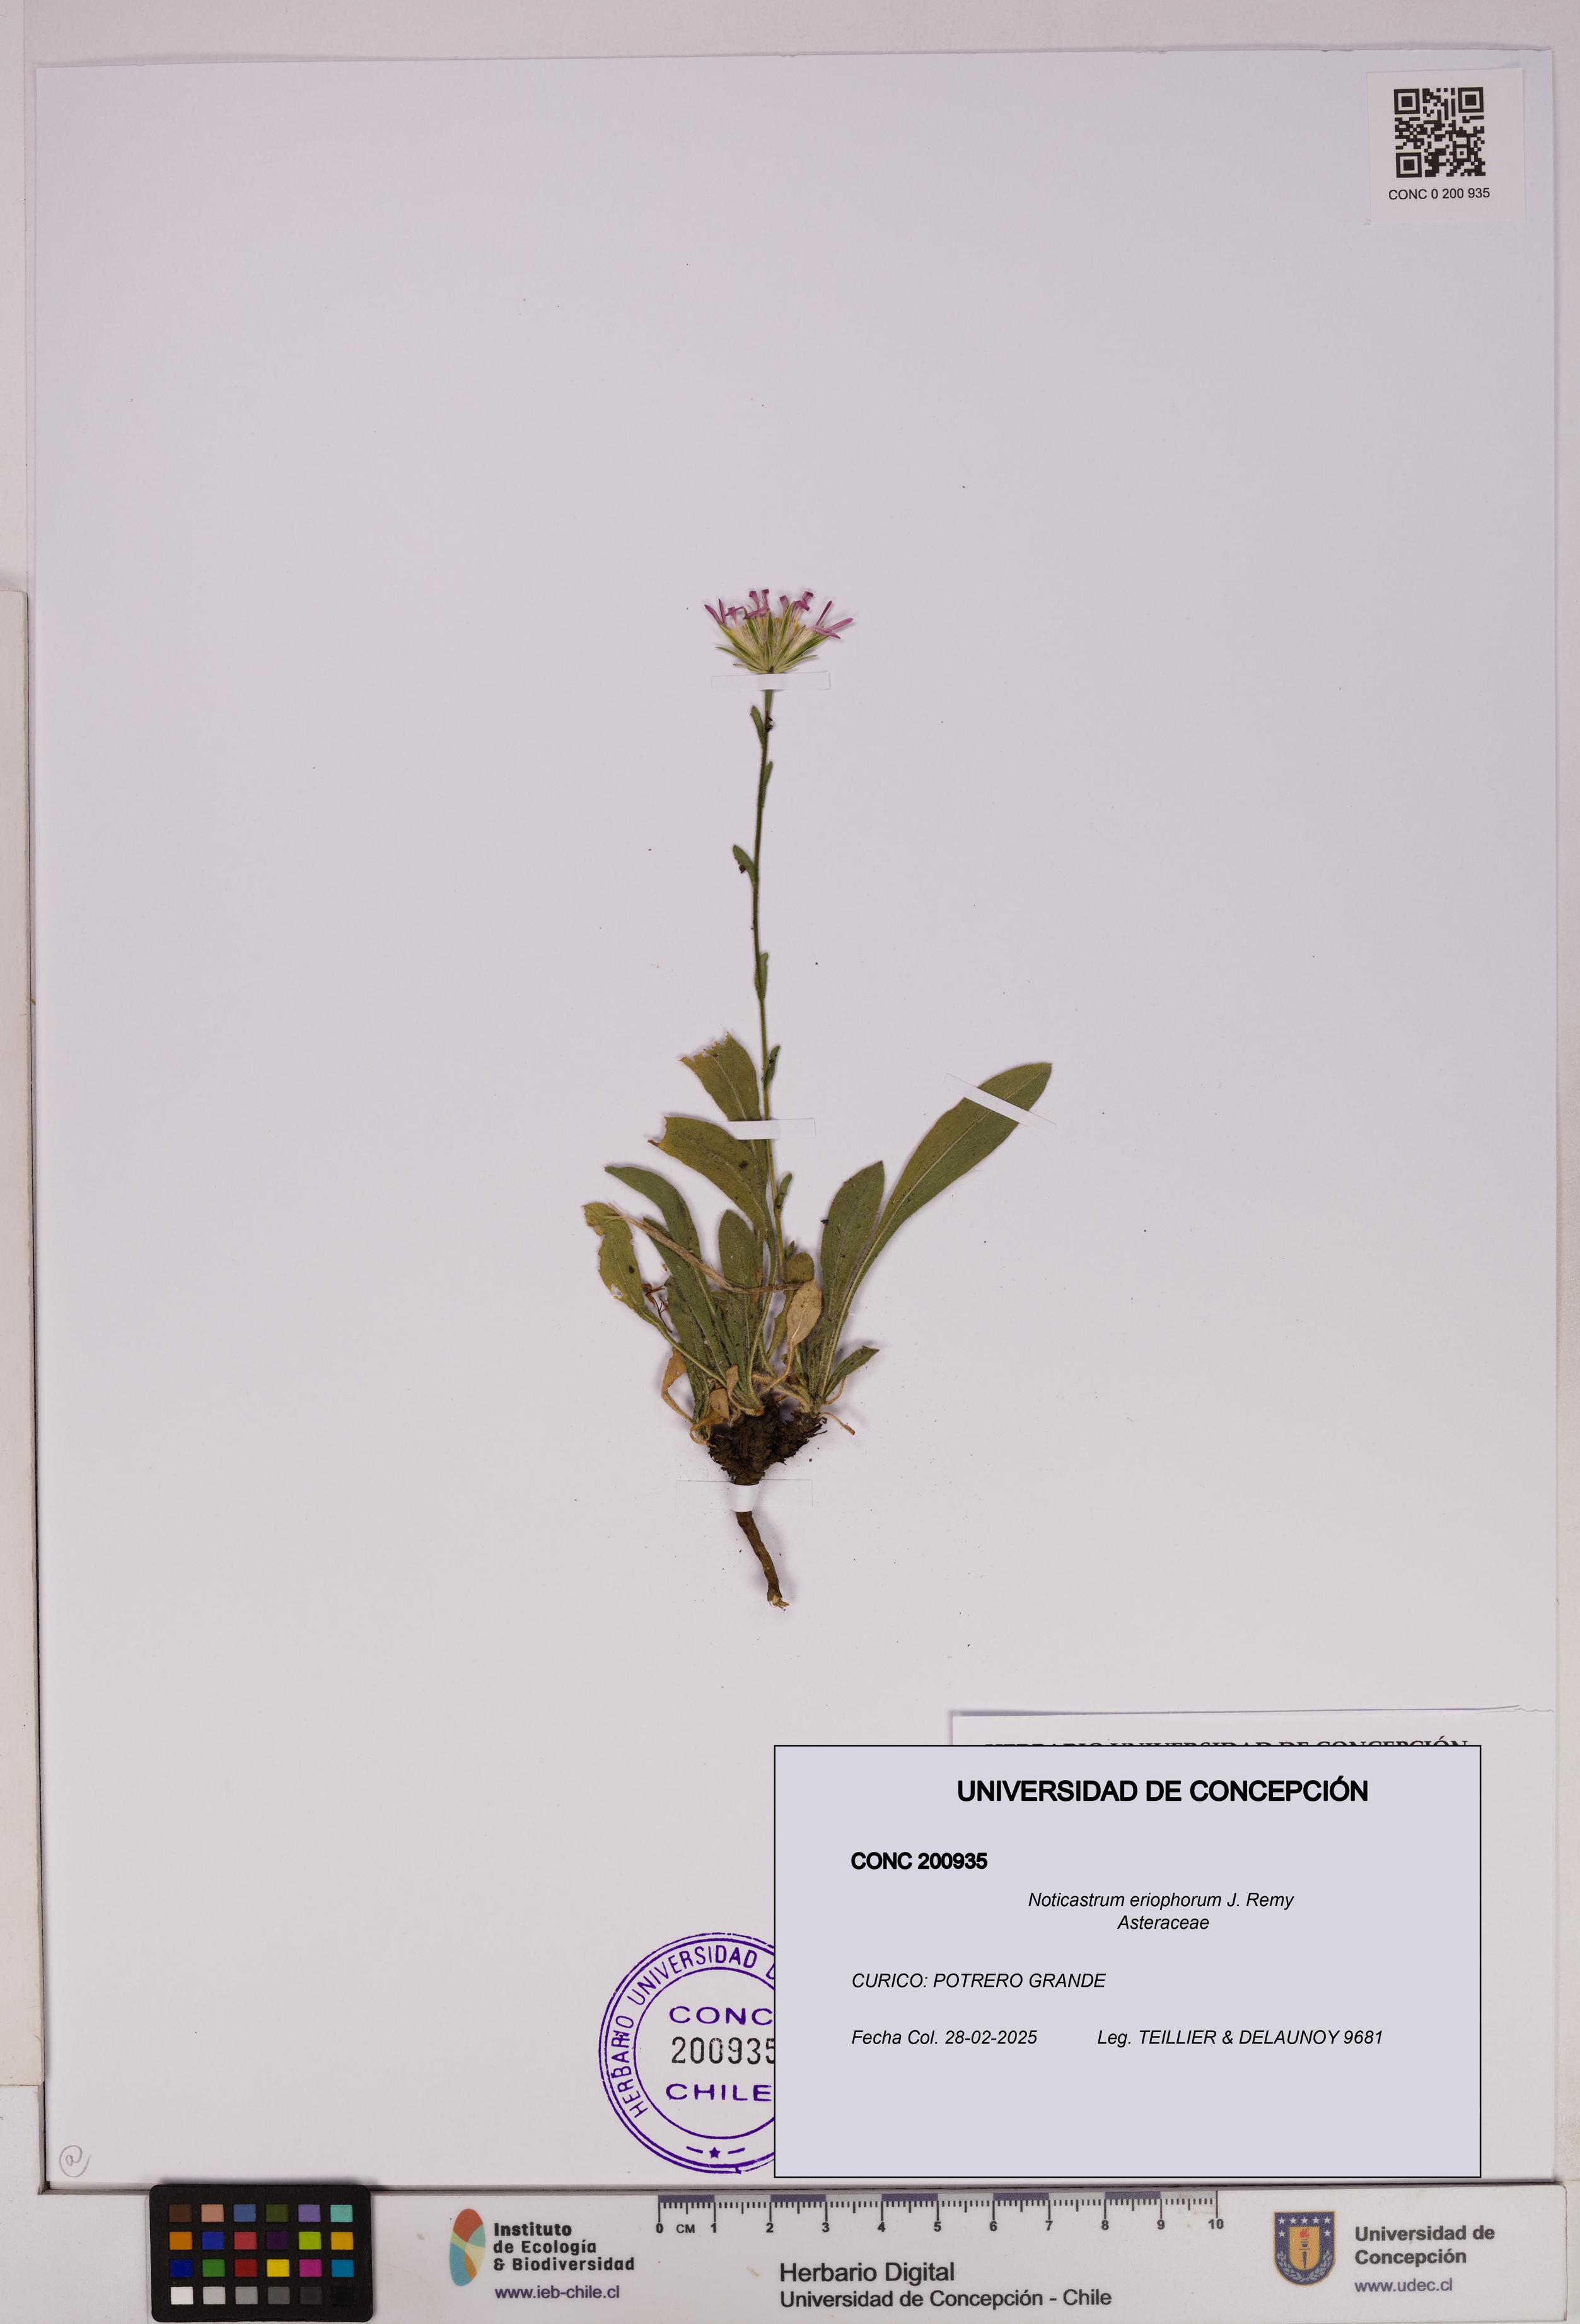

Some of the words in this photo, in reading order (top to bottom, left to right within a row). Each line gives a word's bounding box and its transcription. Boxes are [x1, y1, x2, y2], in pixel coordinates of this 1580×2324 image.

[1388, 188, 1427, 200] CONC
[1431, 189, 1438, 199] 0
[1442, 188, 1464, 199] 200
[1468, 188, 1490, 199] 935
[627, 1945, 757, 2006] UNIVERSIDAD
[669, 2006, 773, 2026] CONC
[671, 2037, 774, 2065] 200935
[666, 2083, 772, 2101] CHILE
[494, 2222, 572, 2236] Instituto
[656, 2223, 664, 2234] 0
[676, 2224, 695, 2233] CM
[710, 2223, 717, 2233] 1
[766, 2223, 774, 2233] 2
[822, 2223, 830, 2233] 3
[877, 2222, 886, 2233] 4
[933, 2222, 942, 2233] 5
[989, 2221, 997, 2232] 6
[1045, 2221, 1054, 2231] 7
[1101, 2219, 1110, 2231] 8
[1157, 2219, 1166, 2230] 9
[1208, 2219, 1224, 2229] 10
[1355, 2225, 1467, 2242] Universidad
[1472, 2224, 1496, 2240] de
[493, 2240, 514, 2253] de
[521, 2240, 596, 2256] Ecología
[494, 2258, 505, 2271] &
[512, 2257, 635, 2271] Biodiversidad
[1354, 2248, 1467, 2268] Concepción
[780, 2262, 877, 2282] Herbario
[885, 2262, 955, 2287] Digital
[494, 2285, 620, 2299] www.ieb-chile.cl
[1354, 2277, 1453, 2292] www.udec.cl
[781, 2291, 893, 2308] Universidad
[899, 2290, 924, 2307] de
[929, 2289, 1043, 2310] Concepción
[1063, 2289, 1112, 2306] Chile
